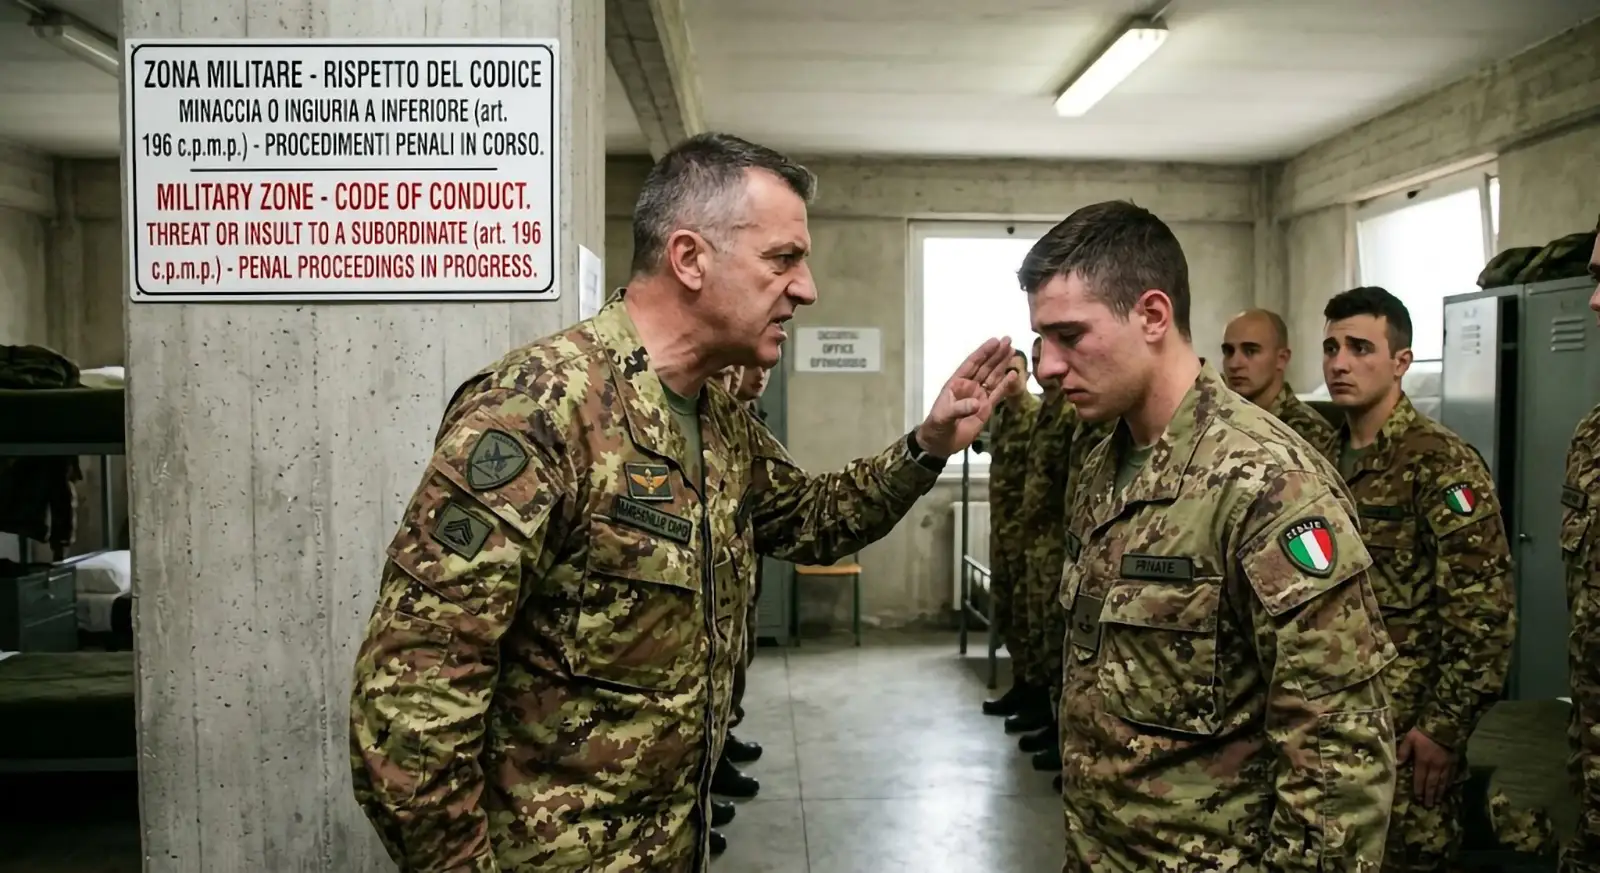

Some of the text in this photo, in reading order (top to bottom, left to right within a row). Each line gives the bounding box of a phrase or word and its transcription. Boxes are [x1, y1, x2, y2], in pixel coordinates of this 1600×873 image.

[143, 59, 201, 89] ZONA
[207, 59, 303, 89] MILITARE
[324, 59, 419, 89] RISPETTO
[427, 60, 464, 88] DEL
[470, 59, 542, 89] CODICE
[179, 98, 508, 128] MINACCIA O INGIURIA A INFERIORE (art.
[142, 132, 172, 157] 196
[177, 132, 248, 162] c.p.m.p.)
[265, 132, 390, 157] PROCEDIMENTI
[396, 132, 454, 156] PENALI
[460, 131, 477, 156] IN
[482, 131, 544, 156] CORSO.
[157, 182, 253, 211] MILITARY
[259, 182, 314, 211] ZONE
[335, 181, 390, 211] CODE
[396, 181, 423, 211] OF
[429, 181, 531, 211] CONDUCT.
[146, 220, 542, 250] THREAT OR INSULT TO A SUBORDINATE (art. 196
[151, 255, 221, 285] c.p.m.p.)
[238, 255, 293, 279] PENAL
[298, 253, 415, 279] PROCEEDINGS
[421, 254, 437, 278] IN
[443, 253, 537, 278] PROGRESS.
